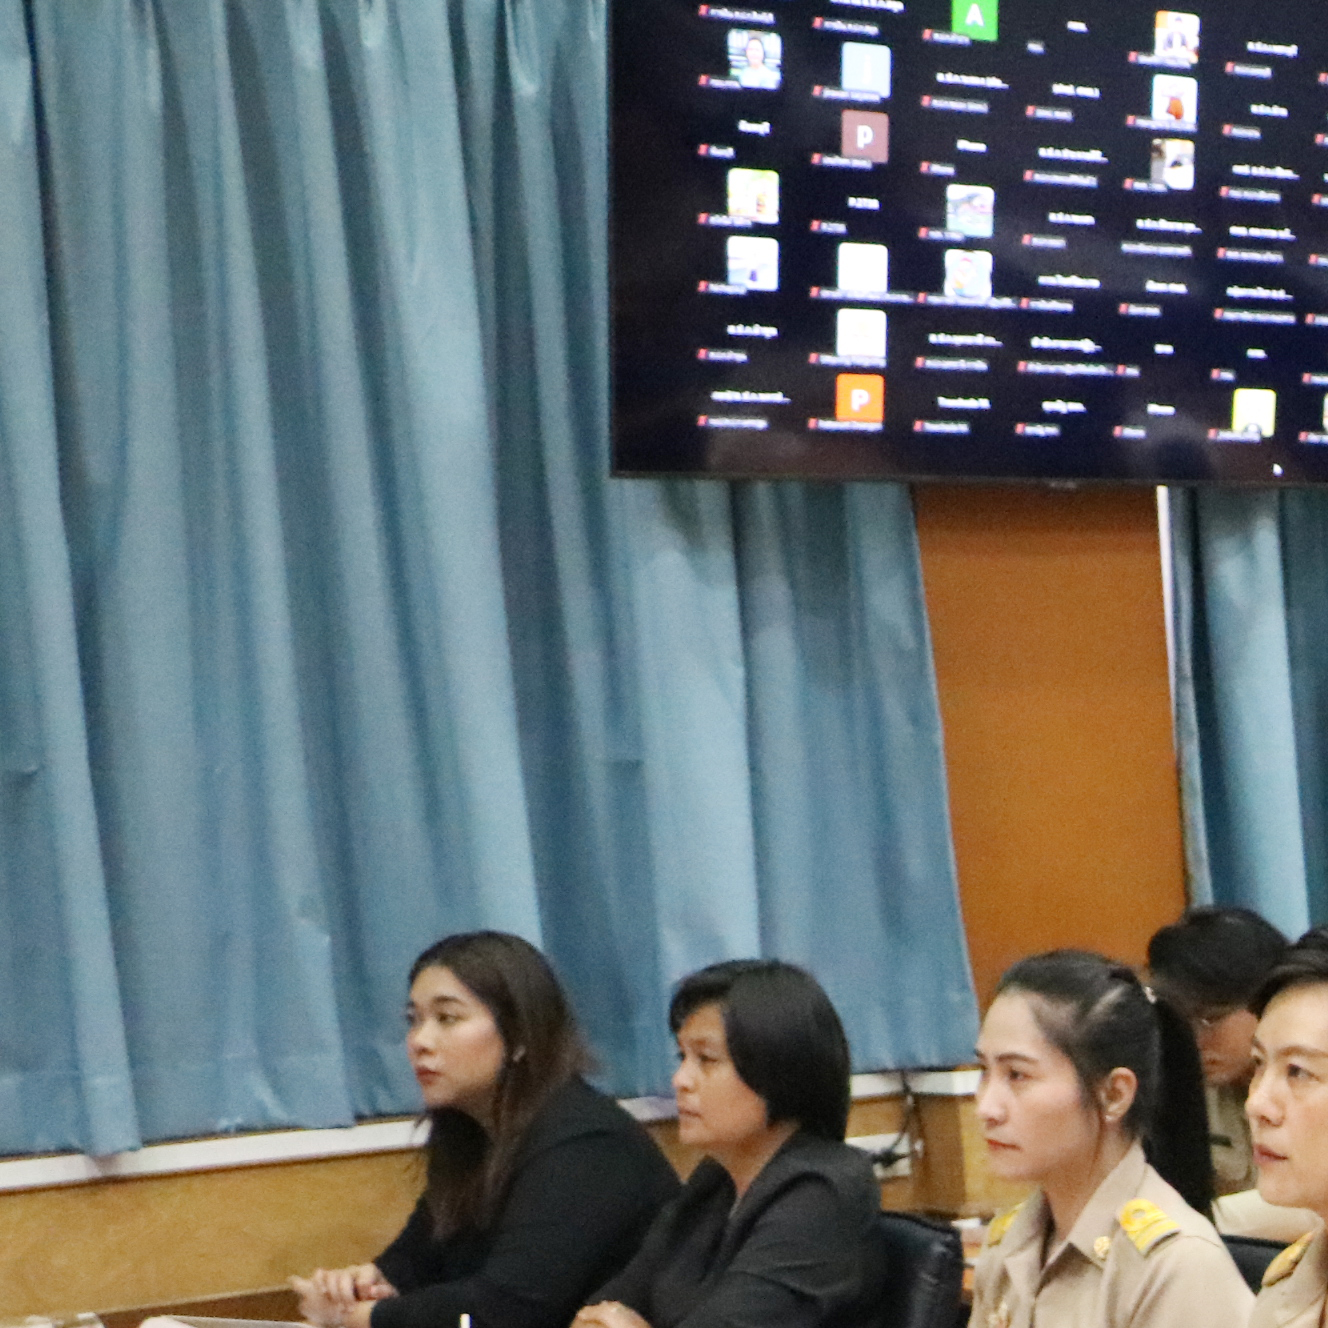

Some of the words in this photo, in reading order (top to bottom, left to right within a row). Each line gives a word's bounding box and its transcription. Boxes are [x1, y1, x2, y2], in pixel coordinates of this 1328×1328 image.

[965, 3, 984, 27] A
[857, 124, 874, 149] P
[851, 389, 871, 412] P
